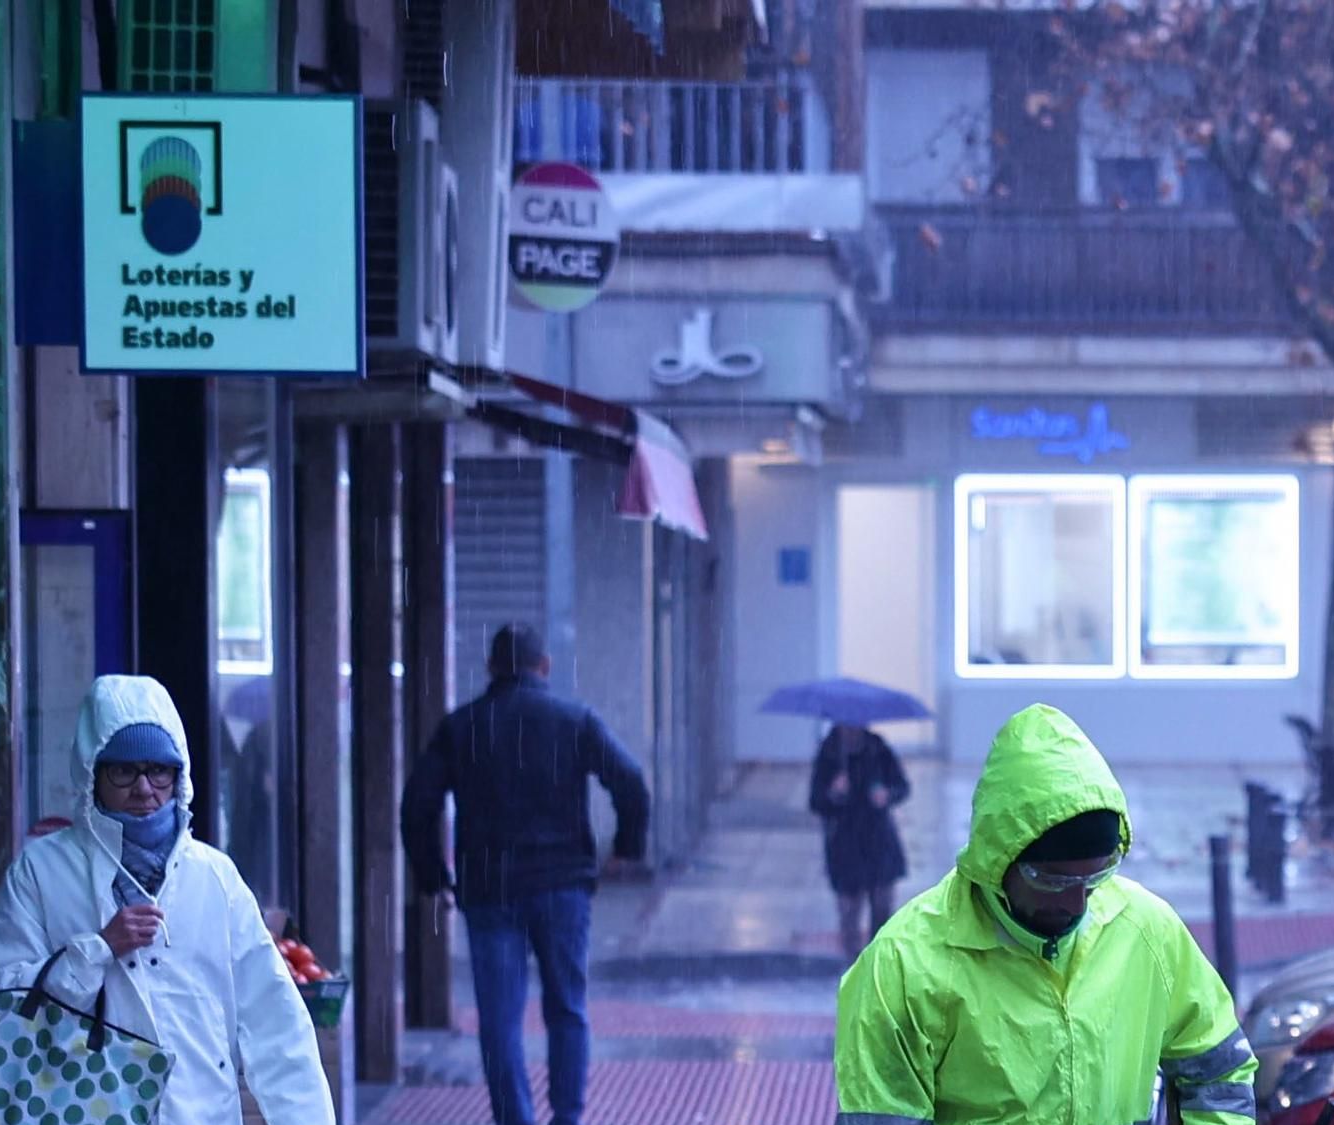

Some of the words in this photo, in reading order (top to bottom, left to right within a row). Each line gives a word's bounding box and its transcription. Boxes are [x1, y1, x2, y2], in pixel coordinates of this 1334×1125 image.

[523, 196, 597, 227] CALI
[519, 243, 601, 278] PAGE
[121, 263, 231, 286] Loterías
[238, 269, 254, 293] y
[123, 294, 247, 323] Apuestas
[255, 294, 296, 318] del
[122, 325, 214, 349] Estado
